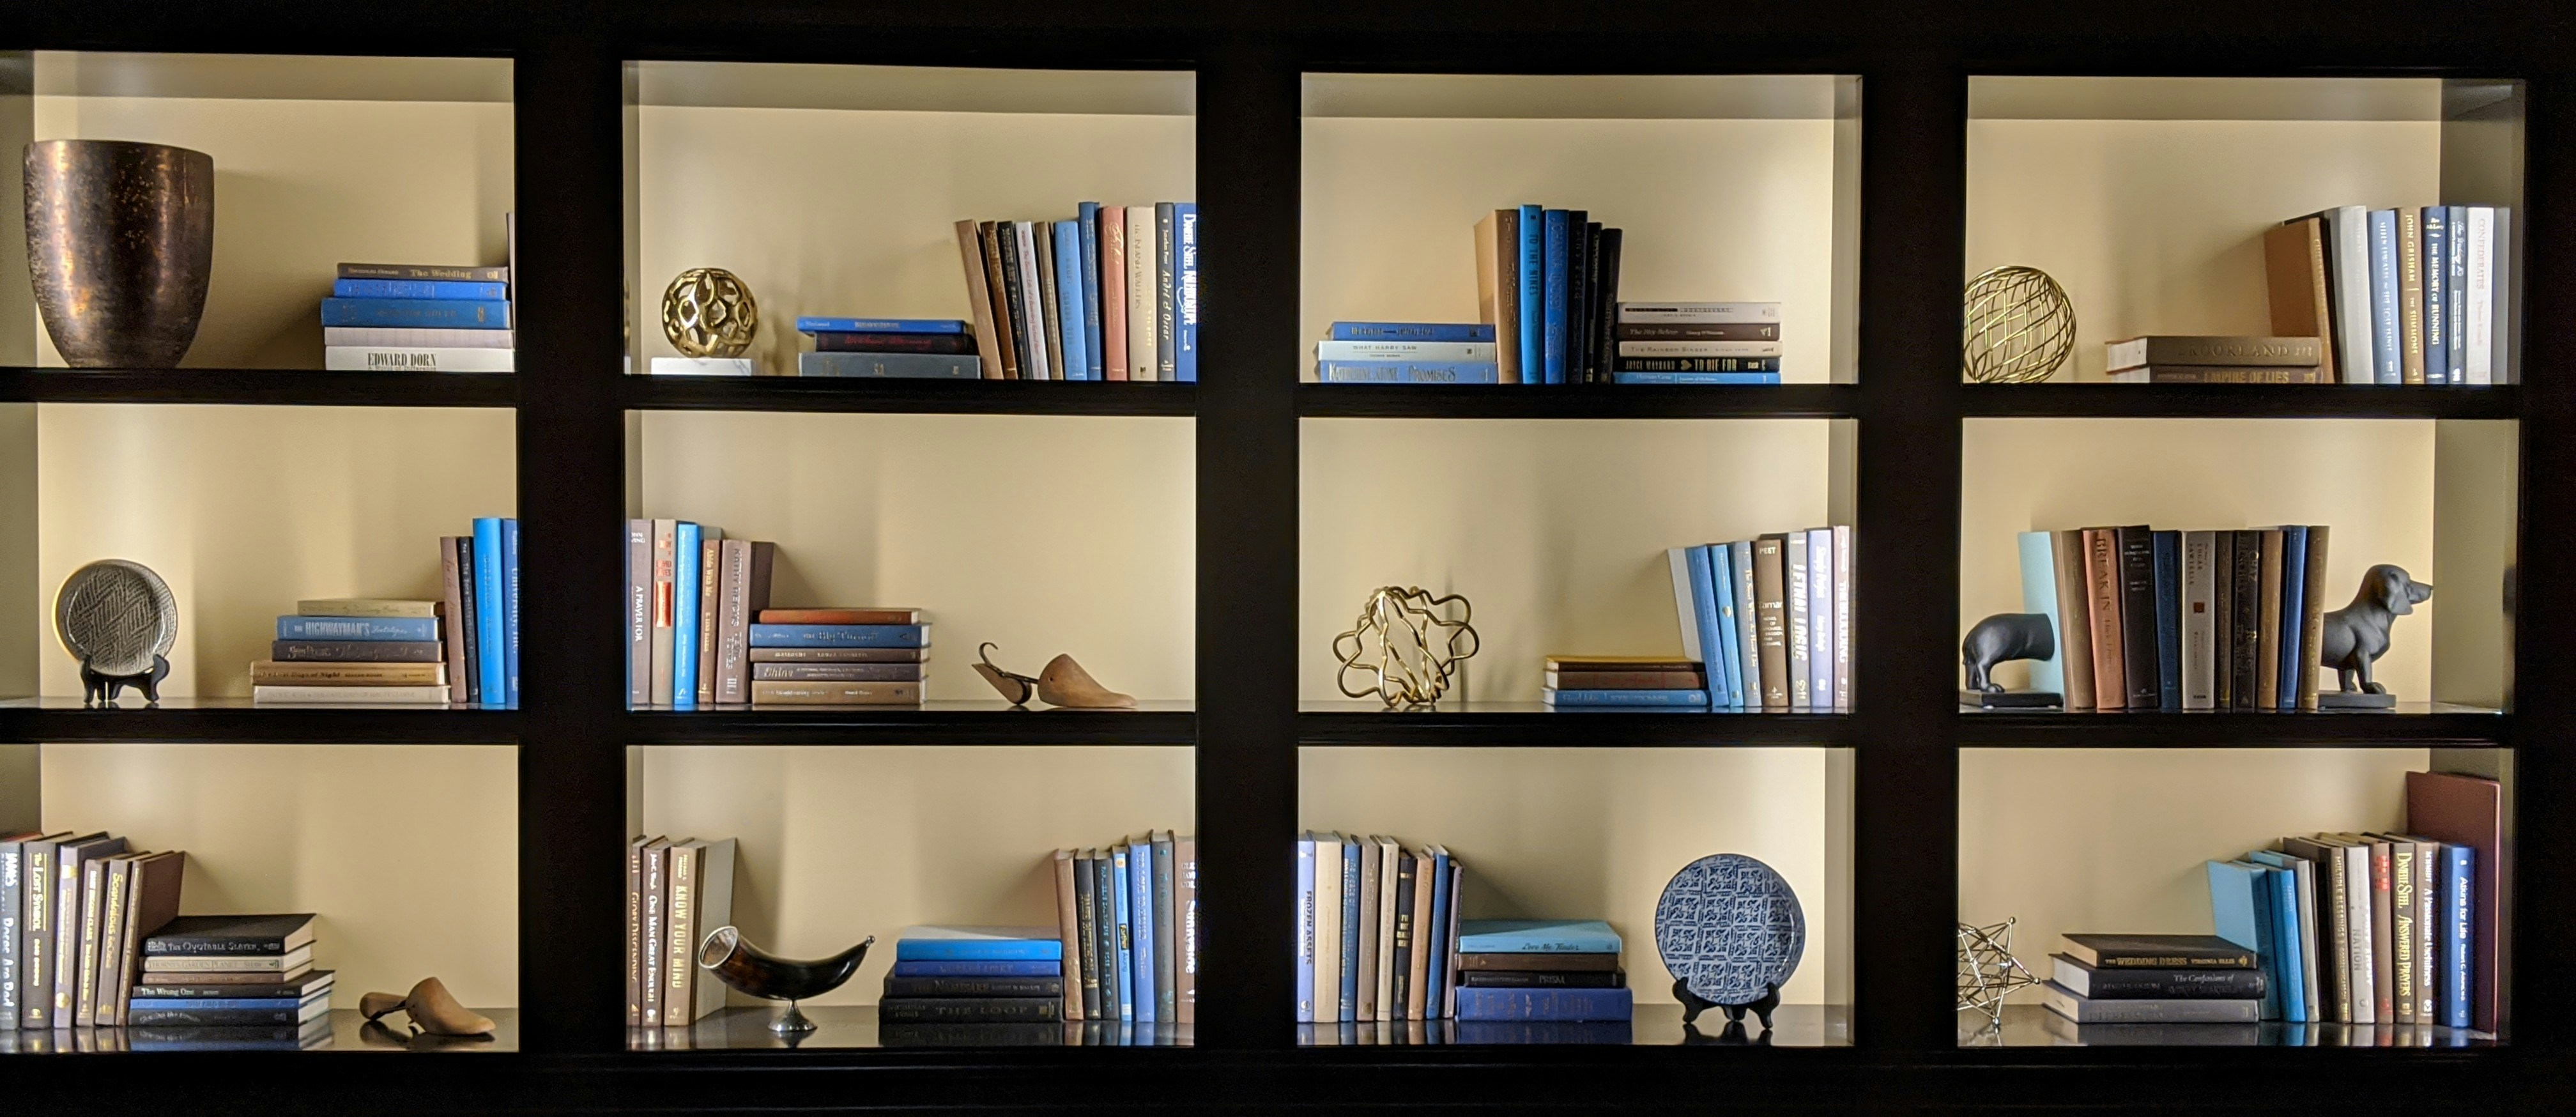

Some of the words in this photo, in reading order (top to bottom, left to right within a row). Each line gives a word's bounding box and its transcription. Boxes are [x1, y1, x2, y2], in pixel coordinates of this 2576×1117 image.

[1529, 234, 1538, 244] TO
[2405, 215, 2414, 238] JOHN
[1183, 245, 1197, 269] STEEL
[1529, 250, 1538, 264] THE
[2407, 242, 2416, 282] GRISHAM
[2476, 218, 2485, 289] CONFEDERATES
[411, 269, 428, 278] The
[431, 270, 472, 280] Wedding
[1163, 270, 1172, 298] André
[2430, 257, 2440, 293] MEMORY
[183, 303, 226, 314] QUOTABLE
[2431, 293, 2438, 302] OF
[1163, 314, 1172, 341] Oscar
[2409, 310, 2418, 354] SUMMONS
[2430, 304, 2440, 346] RUNNING
[367, 353, 408, 367] EDWARD
[411, 353, 437, 367] DORN
[1407, 364, 1456, 381] PROMISES
[1694, 358, 1705, 371] TO
[1706, 358, 1719, 371] DIE
[1722, 359, 1737, 371] FOR
[2249, 371, 2262, 383] OF
[2265, 371, 2288, 383] LIES
[705, 549, 714, 568] Abide
[733, 548, 742, 584] KATHY
[1814, 546, 1827, 573] Simply
[2096, 538, 2110, 590] BREAK
[705, 569, 714, 585] With
[1745, 569, 1753, 581] The
[1791, 564, 1807, 612] LETHAL
[510, 566, 518, 627] University,
[705, 586, 713, 597] Me
[2100, 596, 2111, 611] IN
[634, 594, 643, 623] PRAYER
[731, 587, 741, 628] REICHS
[305, 621, 371, 636] HIGHWAYMAN'S
[634, 625, 643, 642] FOR
[1793, 618, 1808, 661] LOGIC
[4, 852, 18, 887] JAMES
[34, 852, 42, 866] The
[2396, 852, 2413, 884] DANIELLE
[33, 867, 43, 892] LOST
[1137, 870, 1146, 894] LOVE
[2334, 856, 2344, 893] MULTIPLE
[88, 890, 96, 918] HIGGINS
[107, 873, 123, 935] Scandalous
[648, 895, 657, 914] ONE
[675, 884, 688, 919] KNOW
[2396, 884, 2413, 909] STEEL
[2424, 888, 2433, 896] A
[2458, 876, 2467, 907] Atkins
[33, 893, 43, 931] SYMBOL
[2336, 895, 2346, 937] BLESSINGS
[2424, 897, 2432, 941] Passionate
[2459, 907, 2467, 921] for
[648, 916, 657, 937] MAN
[673, 923, 687, 953] YOUR
[1119, 924, 1128, 950] Farther
[1185, 900, 1195, 974] Sunnyside
[2397, 914, 2414, 960] ANSWERED
[2459, 922, 2467, 939] Life
[647, 938, 657, 965] GREAT
[1554, 943, 1579, 951] Tender
[2352, 928, 2363, 971] NATION
[671, 958, 685, 988] MIND
[2116, 957, 2158, 966] WEDDING
[2159, 957, 2188, 966] DRESS
[2423, 942, 2432, 987] Usefulness
[647, 967, 656, 1002] ENOUGH
[1539, 975, 1565, 984] PRISM
[2173, 974, 2187, 983] The
[2188, 973, 2225, 983] Confessions
[2226, 973, 2234, 982] of
[2396, 962, 2413, 996] PRAYERS
[157, 988, 179, 996] Wrong
